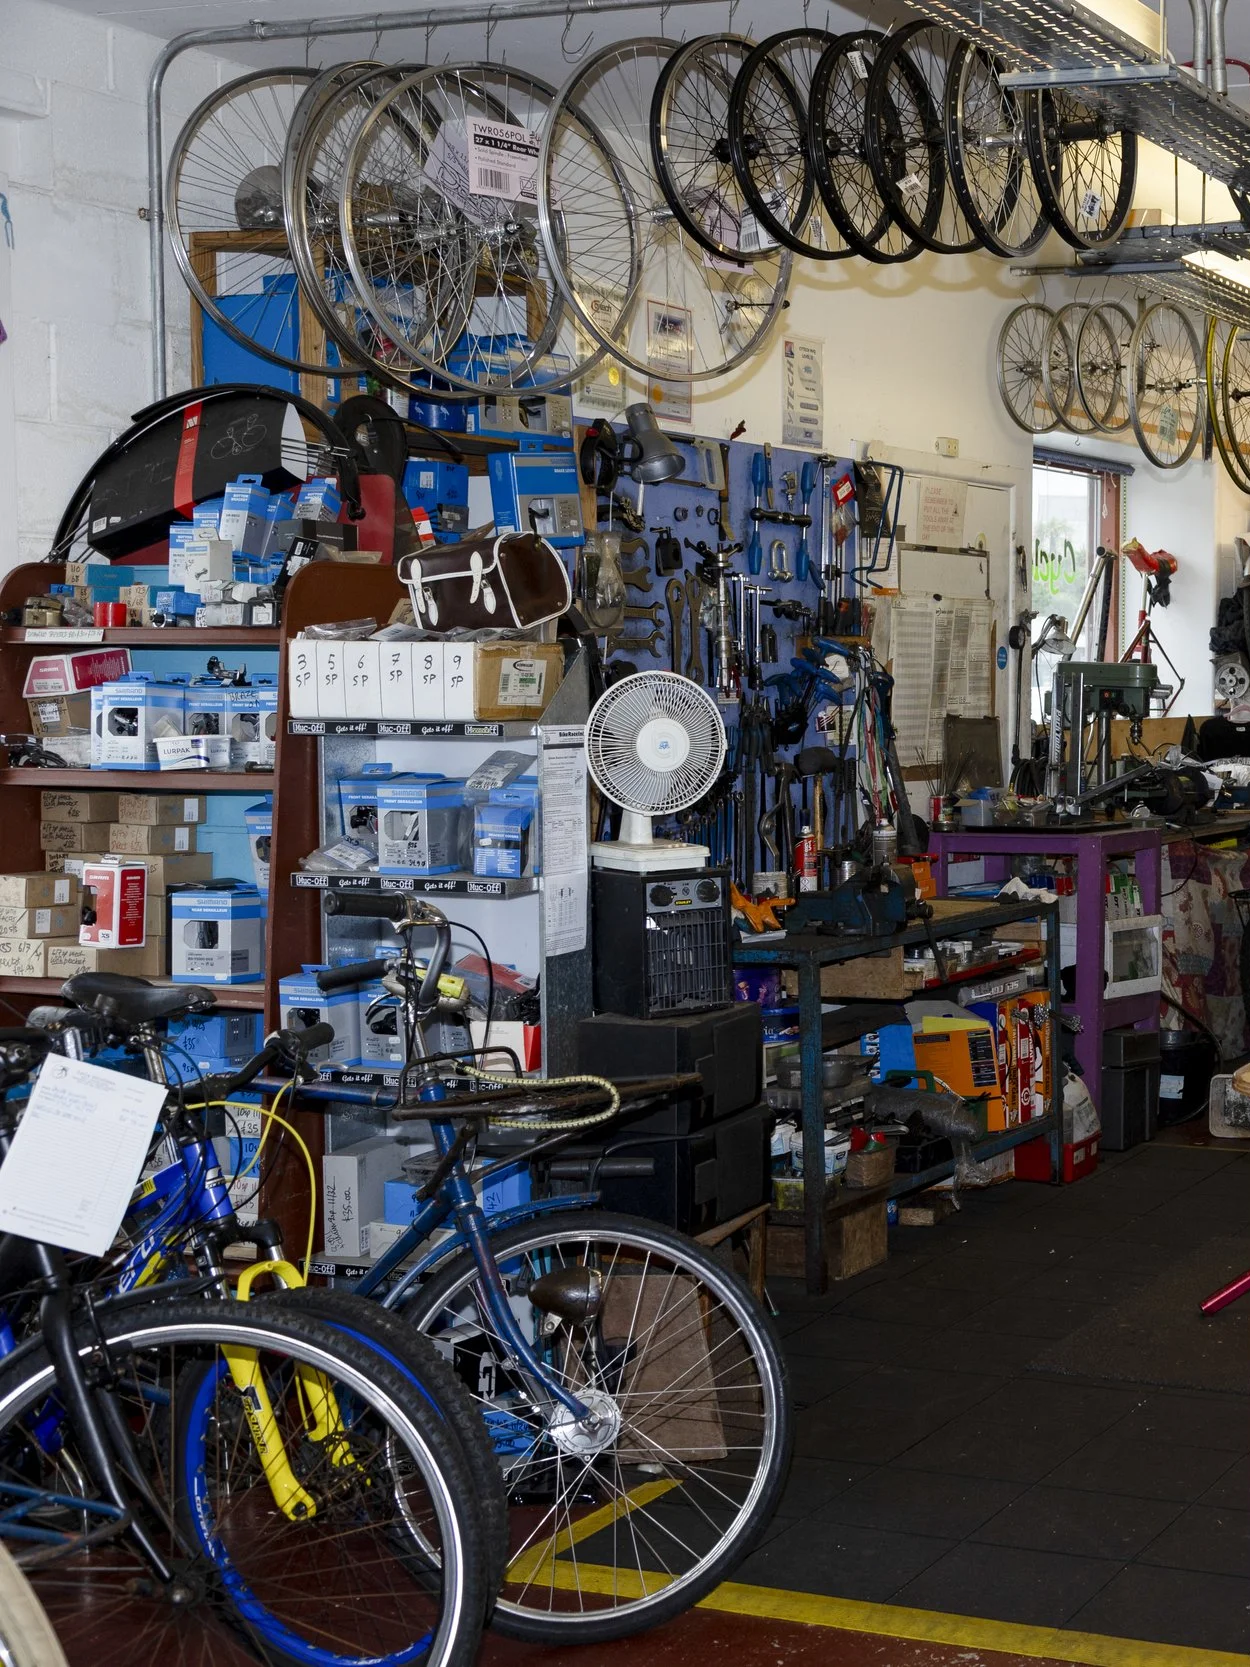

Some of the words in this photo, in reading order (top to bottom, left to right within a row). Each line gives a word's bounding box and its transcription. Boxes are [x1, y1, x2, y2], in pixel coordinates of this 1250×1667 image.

[473, 124, 526, 143] TWR056POL
[512, 144, 526, 153] Rear
[298, 655, 307, 670] 3
[328, 654, 336, 670] 5
[358, 654, 364, 670] 6
[391, 653, 400, 666] 7
[424, 654, 433, 670] 8
[453, 655, 462, 670] 9
[229, 691, 258, 702] BRAZE
[294, 723, 324, 733] Muc-Off
[336, 725, 350, 734] Gets
[354, 724, 368, 732] off!
[379, 724, 410, 734] Muc-Off
[422, 726, 435, 736] Gets
[440, 725, 454, 734] off!
[163, 748, 190, 756] LURPAK
[297, 876, 328, 886] Muc-Off
[339, 879, 352, 888] Gets
[357, 878, 370, 887] off!
[382, 879, 414, 890] Muc-Off
[425, 882, 438, 891] Gets
[444, 881, 457, 890] off!
[469, 882, 500, 894] Muc-Off
[294, 987, 322, 995] SHIMAN
[183, 1036, 196, 1050] £35
[182, 1063, 195, 1074] 9sp
[342, 1074, 356, 1083] Gets
[362, 1074, 374, 1083] off!
[240, 1120, 260, 1136] £35
[346, 1268, 358, 1278] Gets
